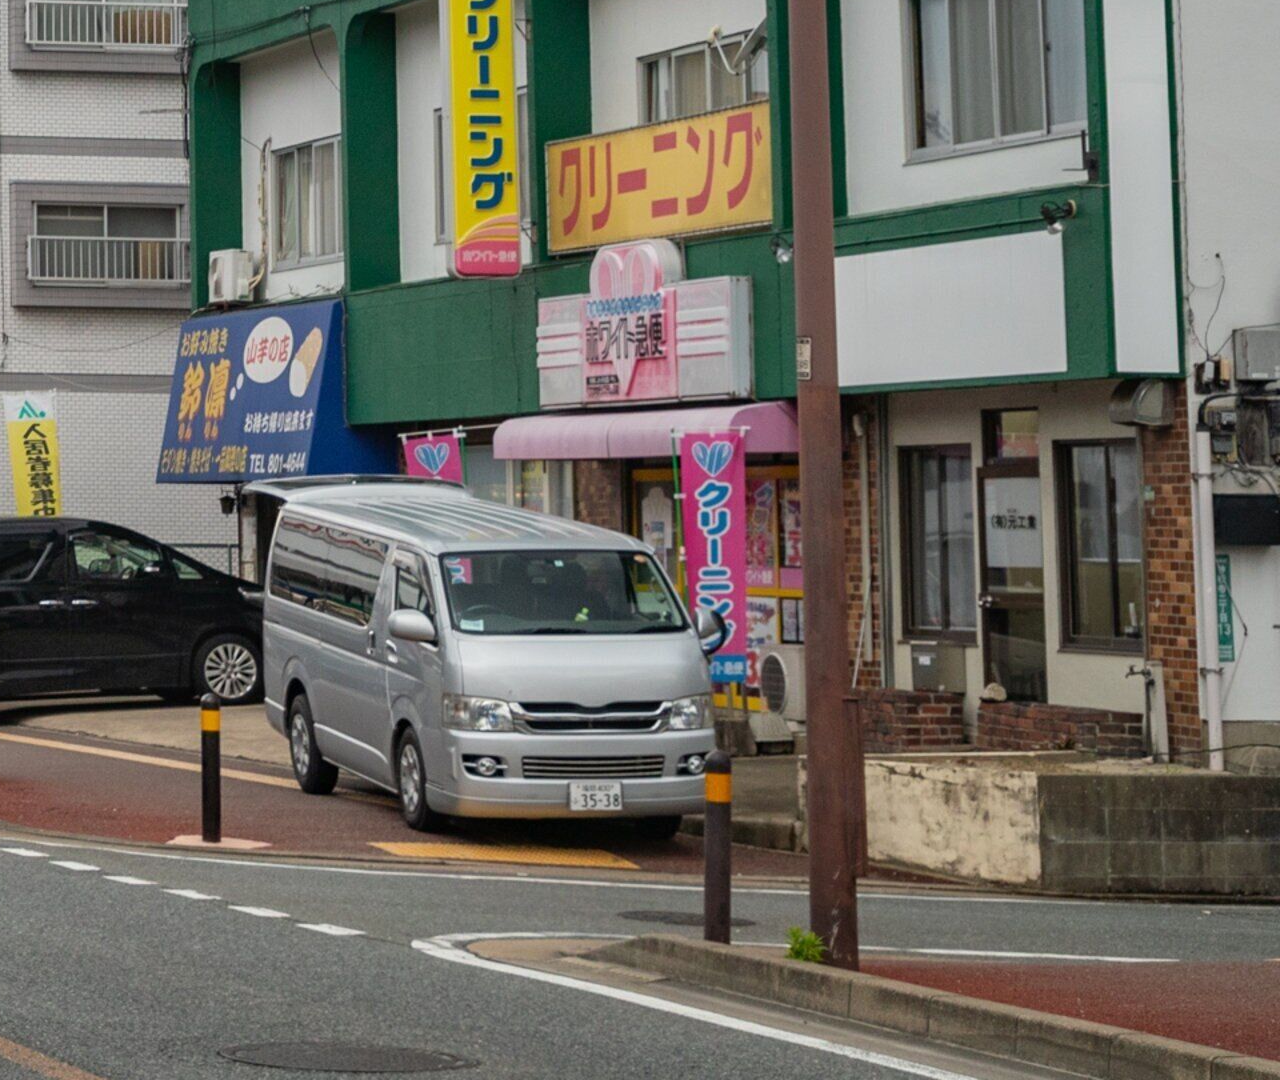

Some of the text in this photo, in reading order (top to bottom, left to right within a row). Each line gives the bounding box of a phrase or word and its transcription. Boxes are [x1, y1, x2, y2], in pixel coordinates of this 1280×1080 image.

[558, 111, 763, 237] クリーニング
[180, 327, 229, 357] お好み焼き
[246, 334, 291, 365] 山芋の店
[249, 453, 265, 474] TEL
[696, 480, 734, 647] クリーニン
[581, 793, 621, 808] 35-38
